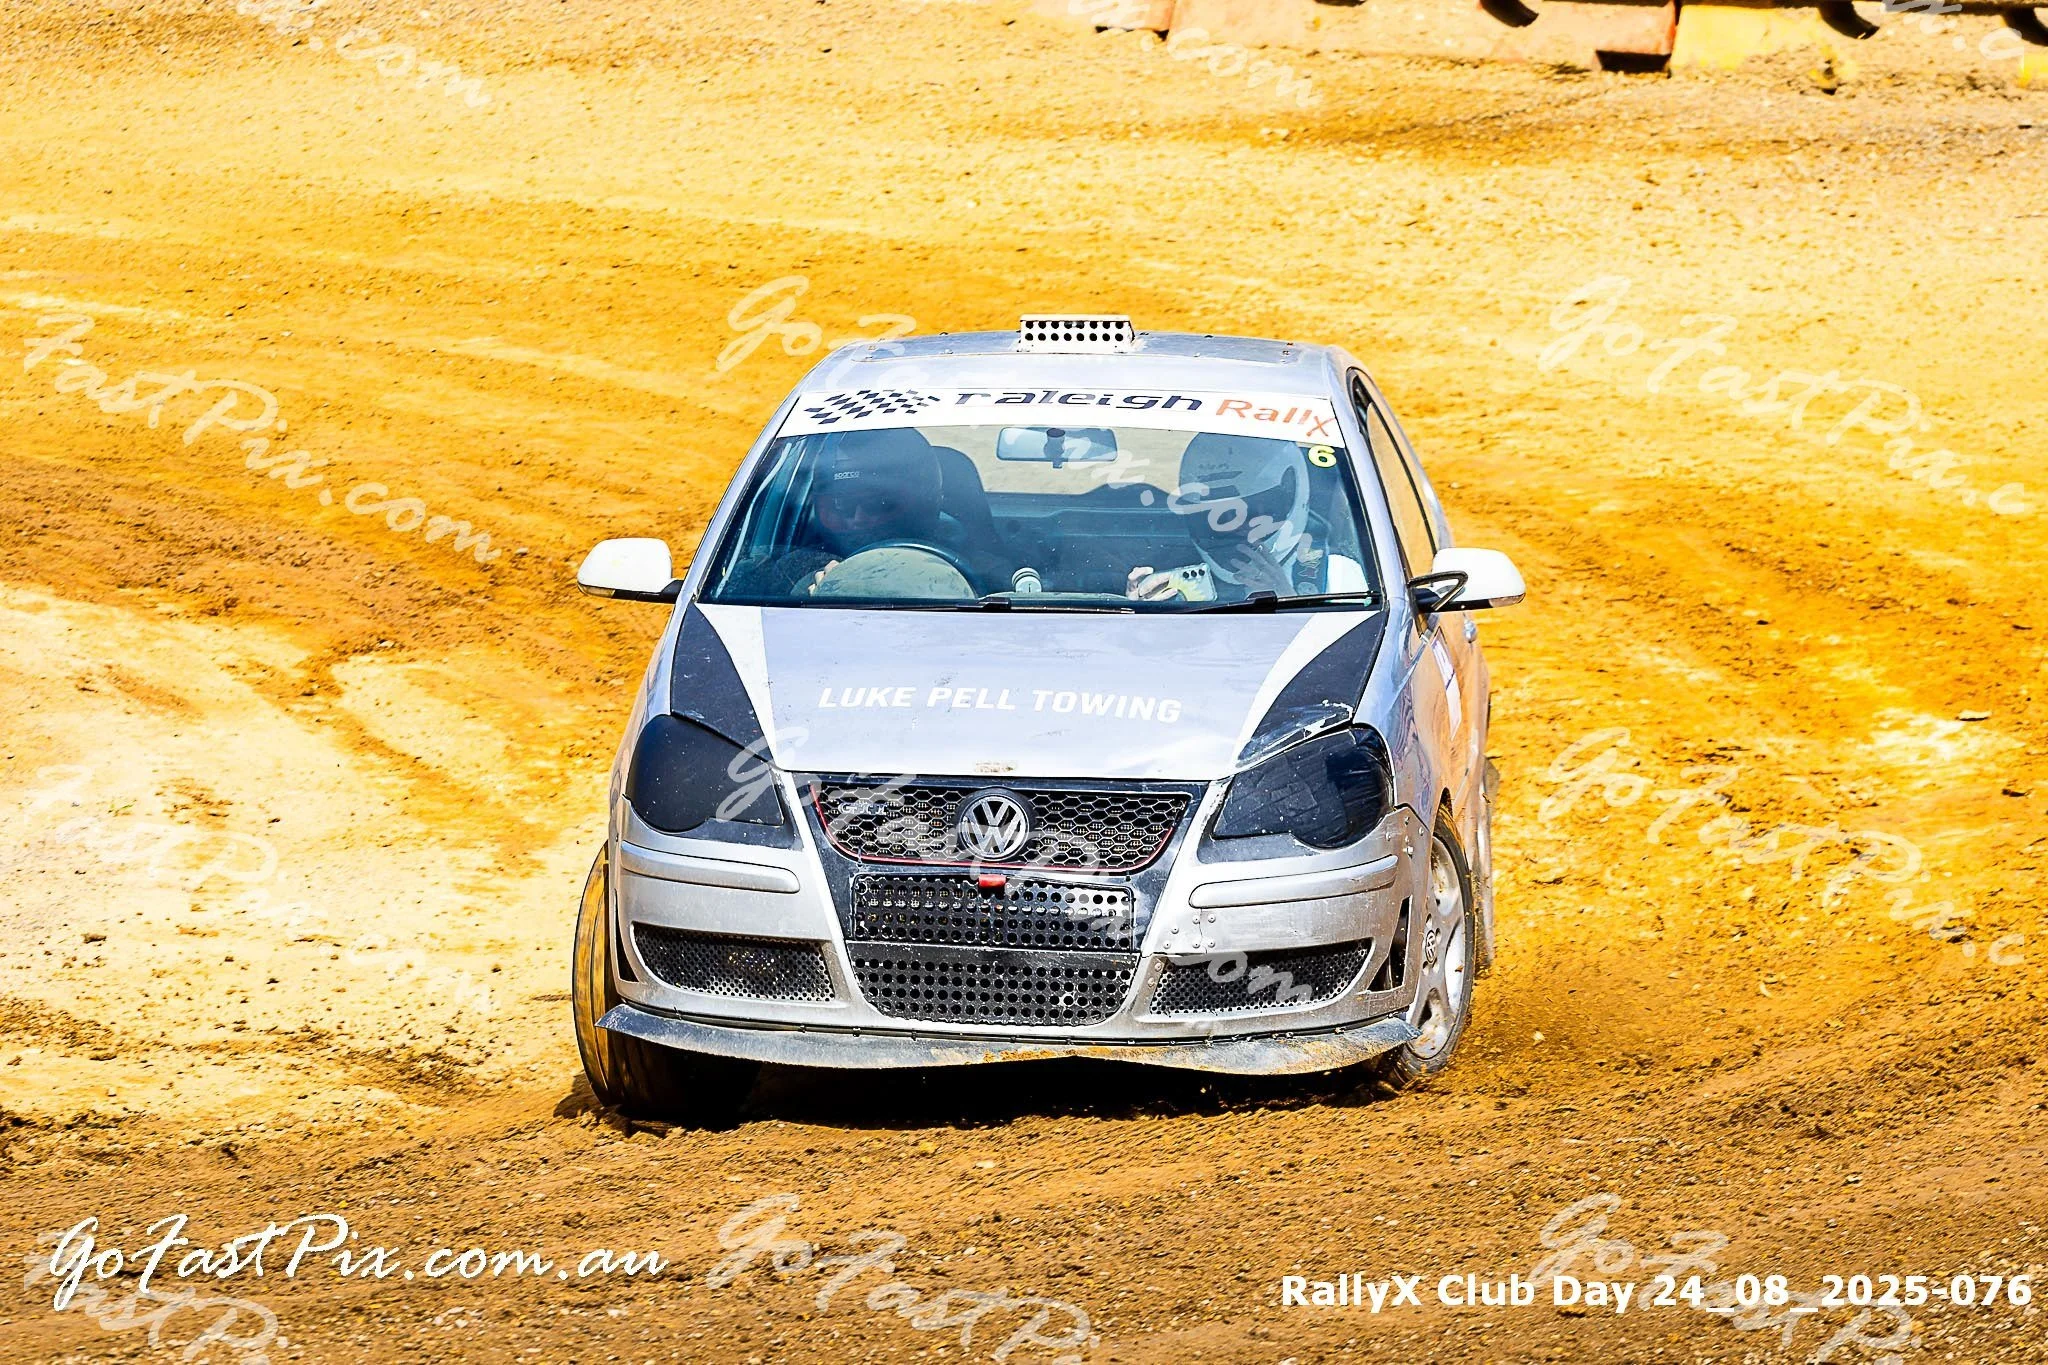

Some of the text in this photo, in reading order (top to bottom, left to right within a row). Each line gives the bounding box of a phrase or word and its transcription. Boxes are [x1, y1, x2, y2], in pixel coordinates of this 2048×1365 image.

[954, 390, 1202, 410] raleigh
[1308, 444, 1338, 468] 6
[818, 687, 1182, 724] LUKE PELL TOWING
